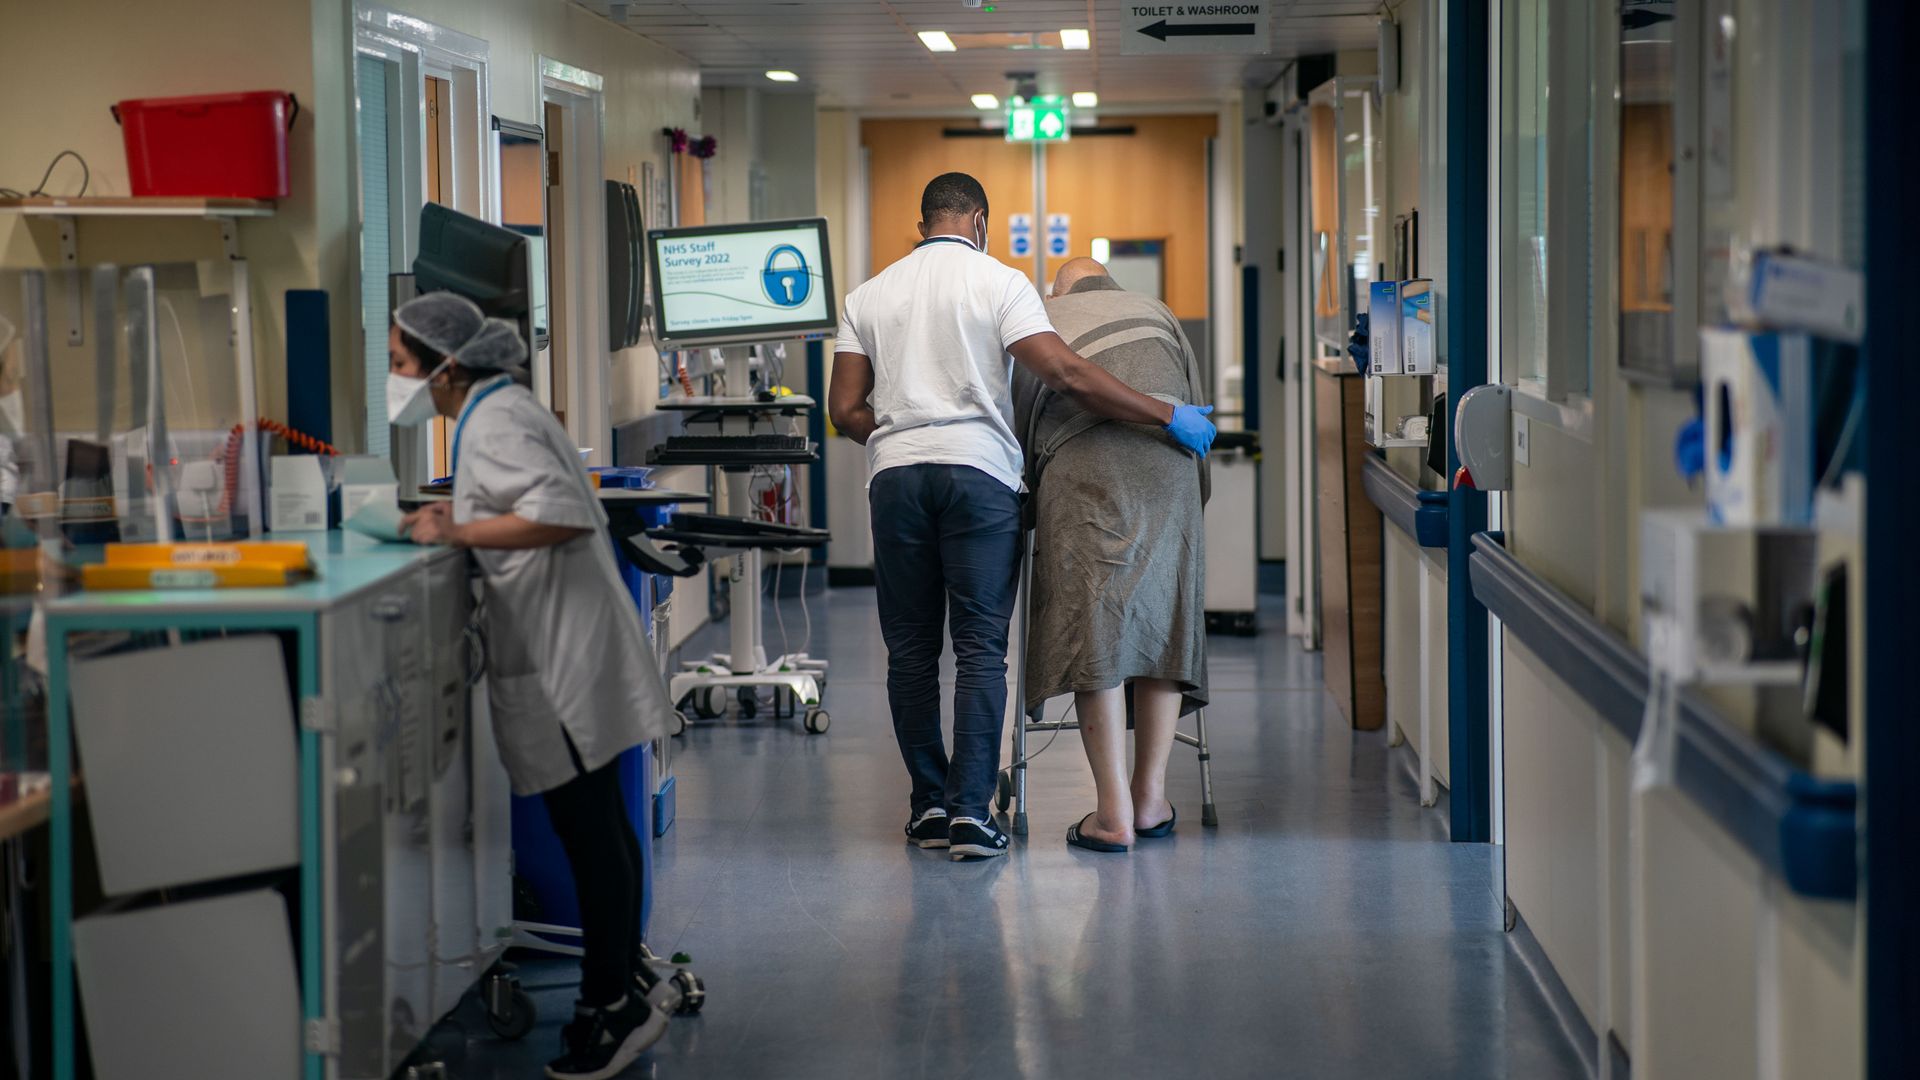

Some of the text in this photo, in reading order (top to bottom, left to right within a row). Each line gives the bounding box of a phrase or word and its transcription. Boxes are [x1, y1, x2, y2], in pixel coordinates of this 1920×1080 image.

[1132, 5, 1259, 16] TOILET & WASHROOM
[664, 241, 715, 254] NHS Staff
[665, 253, 730, 268] Survey 2022
